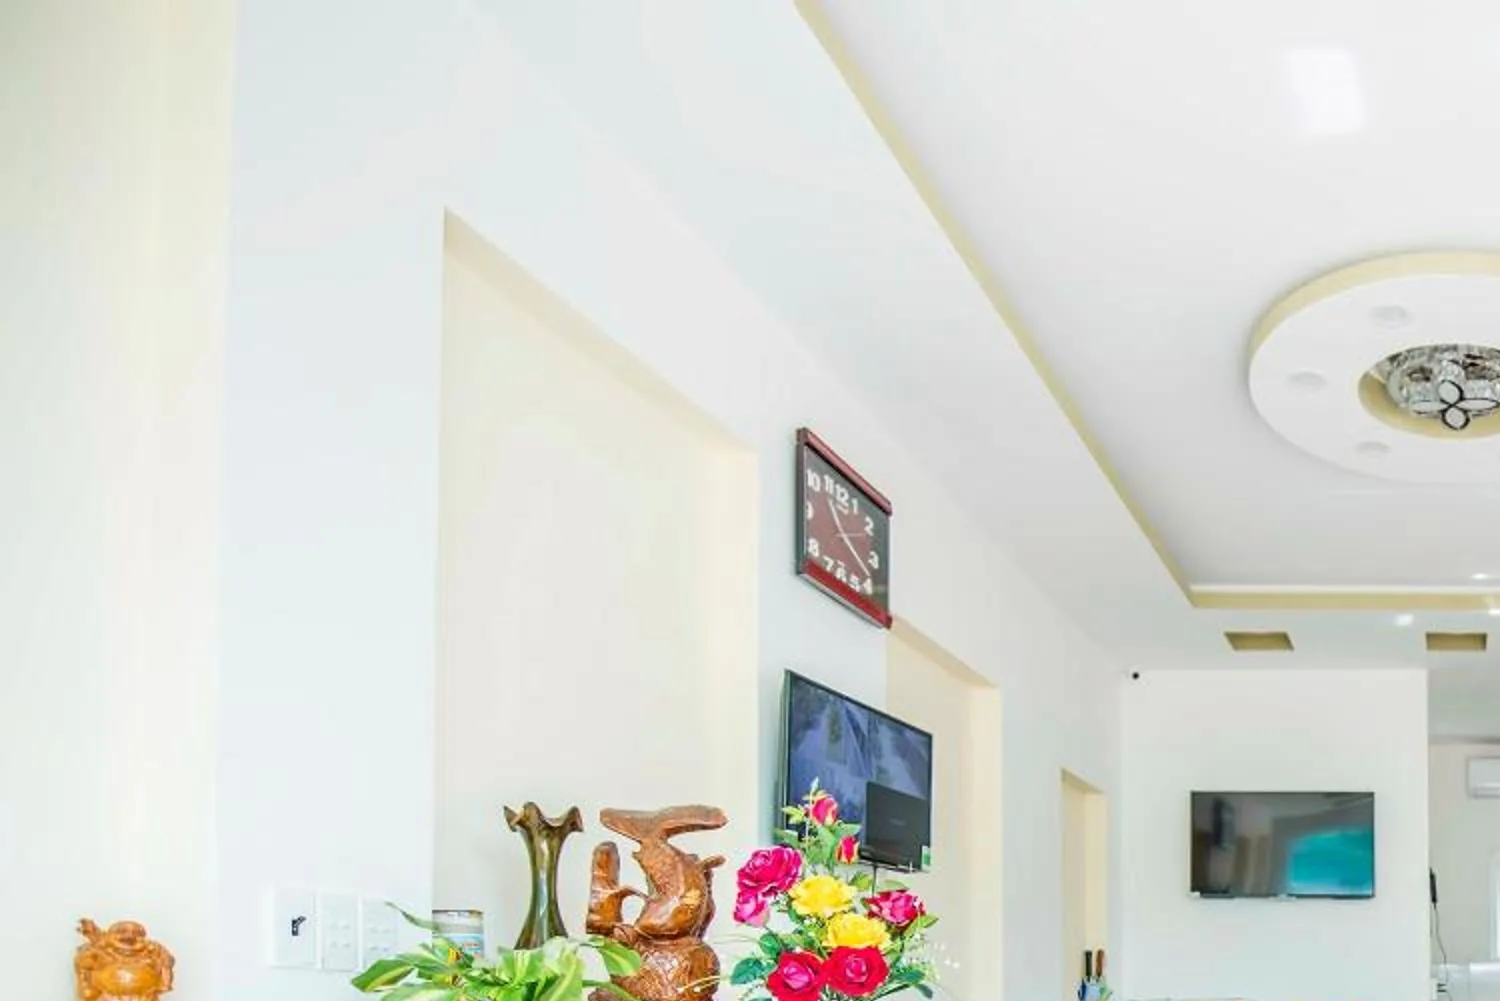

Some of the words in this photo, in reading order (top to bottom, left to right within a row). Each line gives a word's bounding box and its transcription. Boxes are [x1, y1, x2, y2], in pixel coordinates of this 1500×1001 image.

[807, 469, 820, 492] 10
[824, 473, 834, 493] 11
[835, 483, 849, 505] 12
[852, 498, 859, 515] 1
[865, 517, 875, 536] 2
[808, 538, 819, 557] 8
[823, 556, 834, 573] 7
[868, 551, 879, 570] 3
[836, 564, 847, 582] 6
[849, 574, 860, 592] 5
[862, 578, 873, 595] 4
